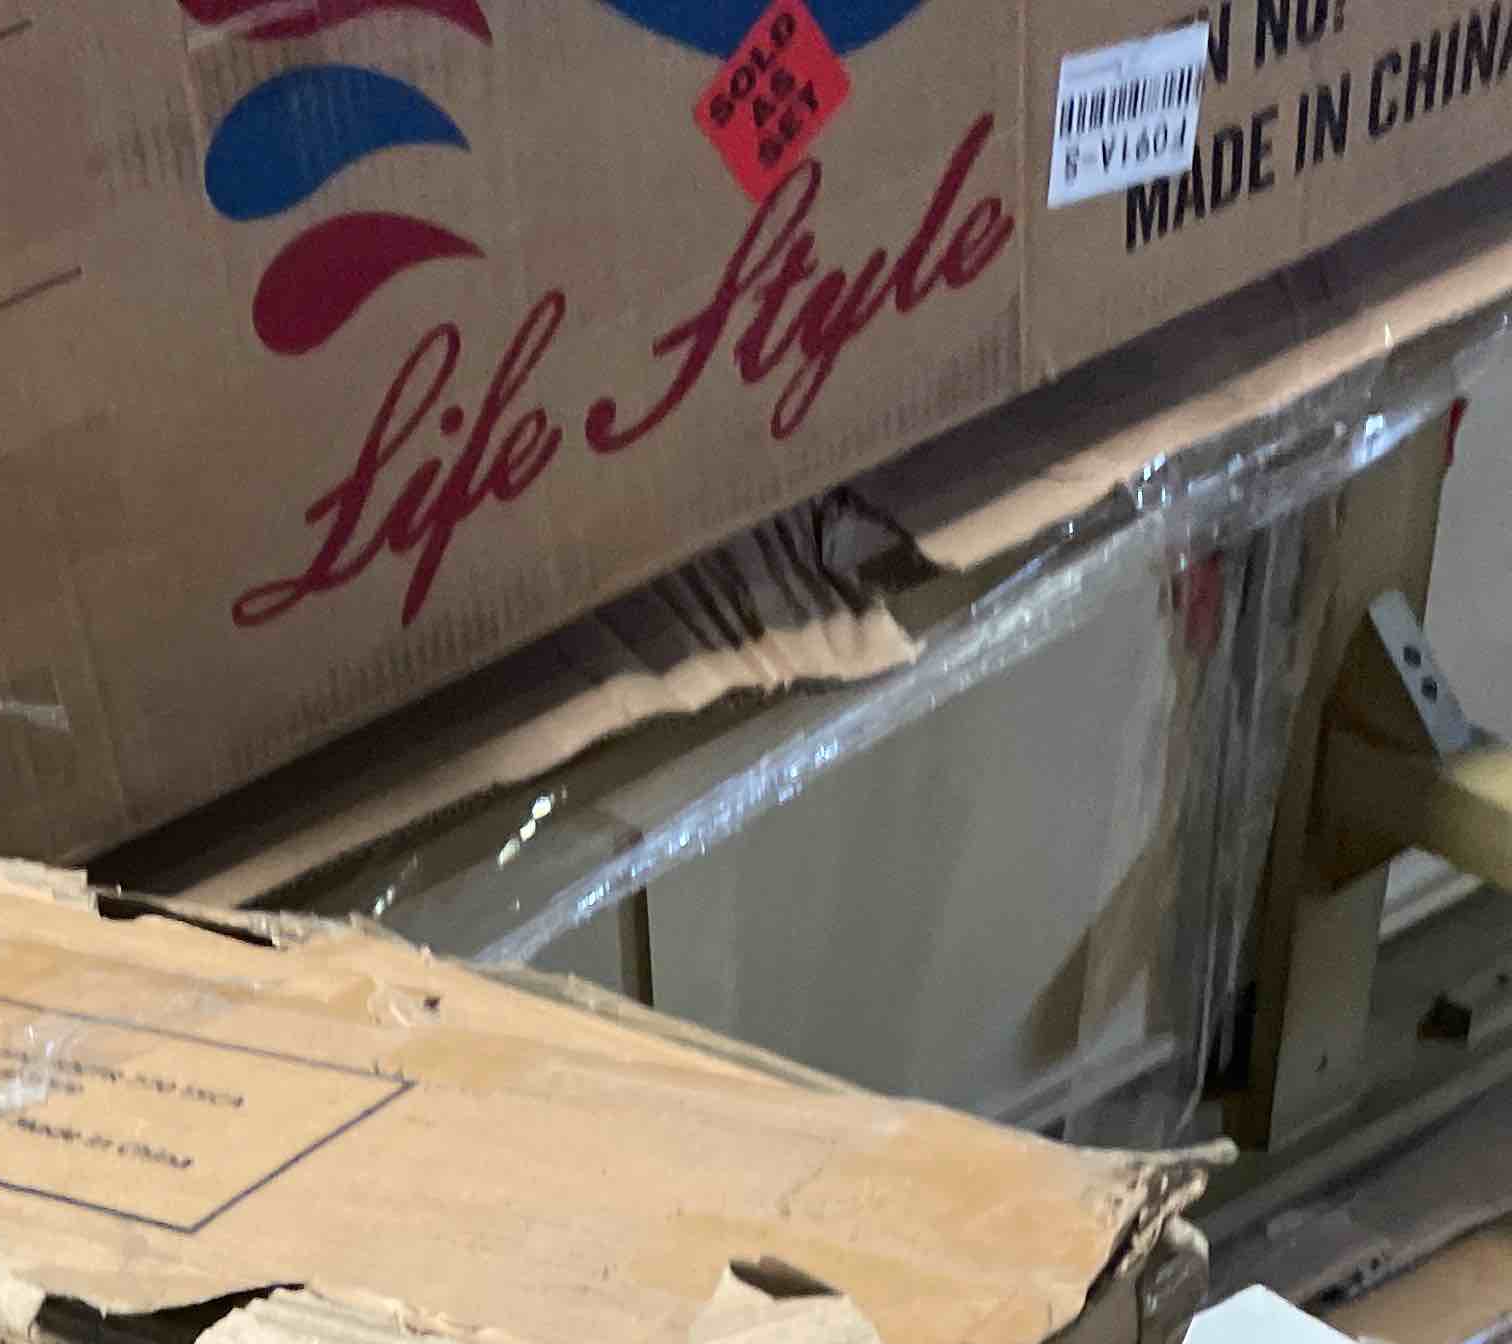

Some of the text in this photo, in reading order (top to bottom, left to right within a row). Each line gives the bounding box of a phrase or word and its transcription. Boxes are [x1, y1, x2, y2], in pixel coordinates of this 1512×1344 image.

[710, 13, 796, 126] SOLD
[1126, 103, 1278, 253] MADE
[1295, 72, 1351, 175] IN
[231, 111, 1017, 629] Life Style
